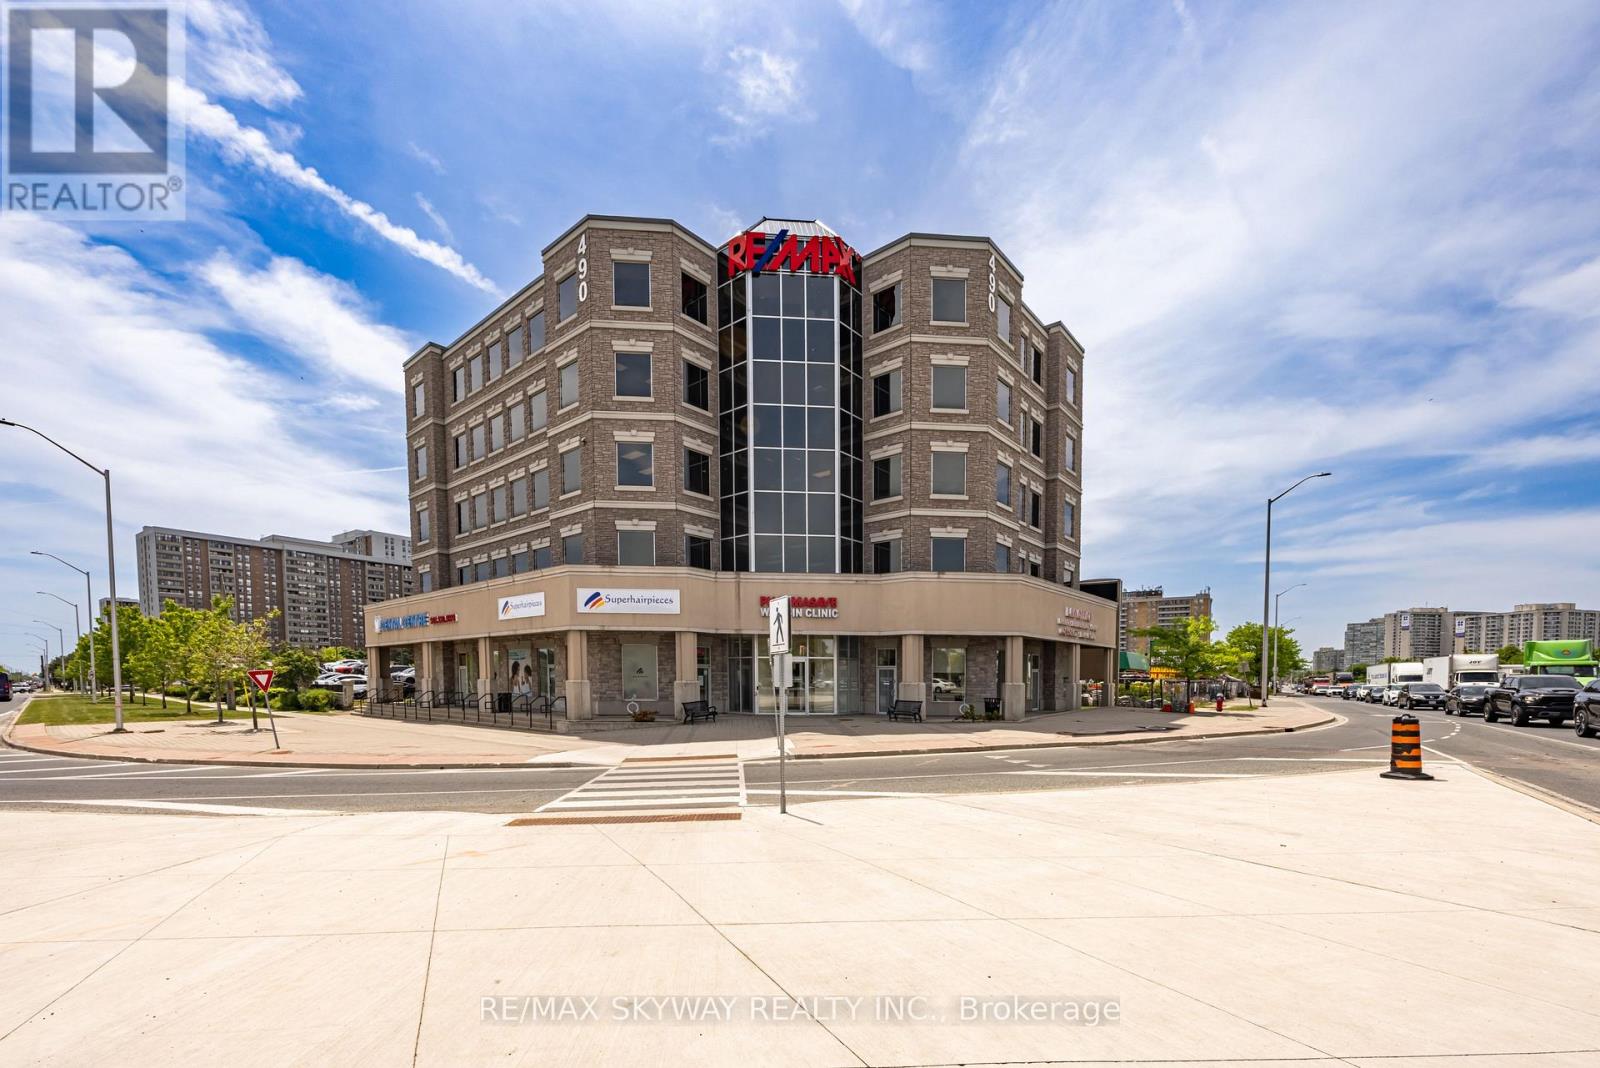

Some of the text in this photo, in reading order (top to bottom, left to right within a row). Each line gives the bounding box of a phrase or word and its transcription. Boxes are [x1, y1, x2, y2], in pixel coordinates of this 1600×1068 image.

[577, 234, 588, 302] 490
[605, 593, 674, 605] Superhairpieces
[805, 608, 839, 618] CLINIC
